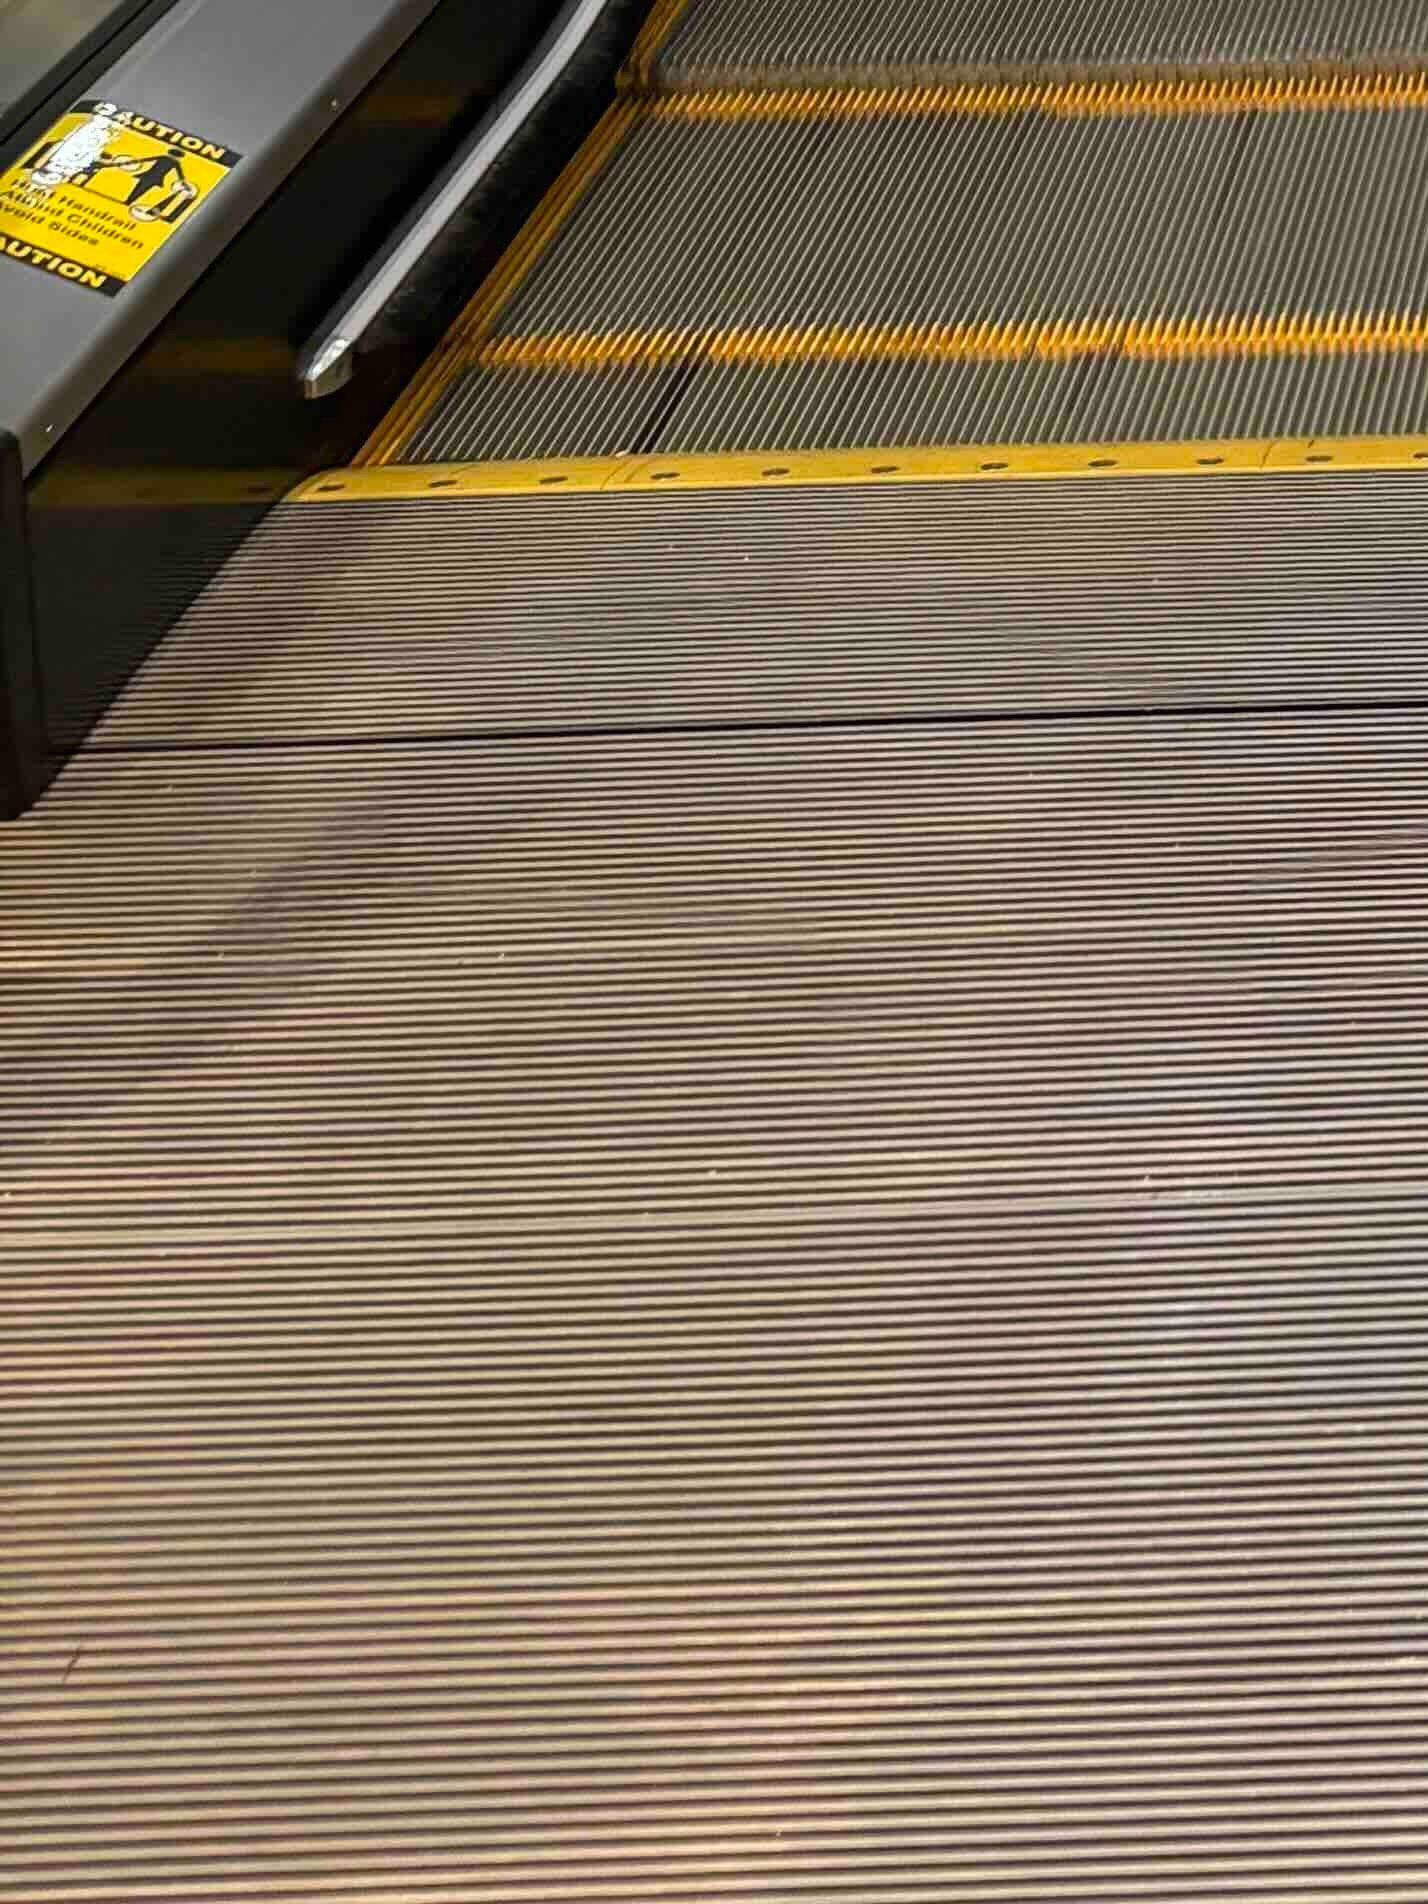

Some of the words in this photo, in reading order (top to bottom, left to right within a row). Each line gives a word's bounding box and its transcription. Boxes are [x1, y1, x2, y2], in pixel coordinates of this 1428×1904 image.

[94, 103, 225, 160] CAUTION
[59, 195, 137, 232] Handrail
[67, 213, 145, 250] Children
[48, 221, 100, 246] Sides
